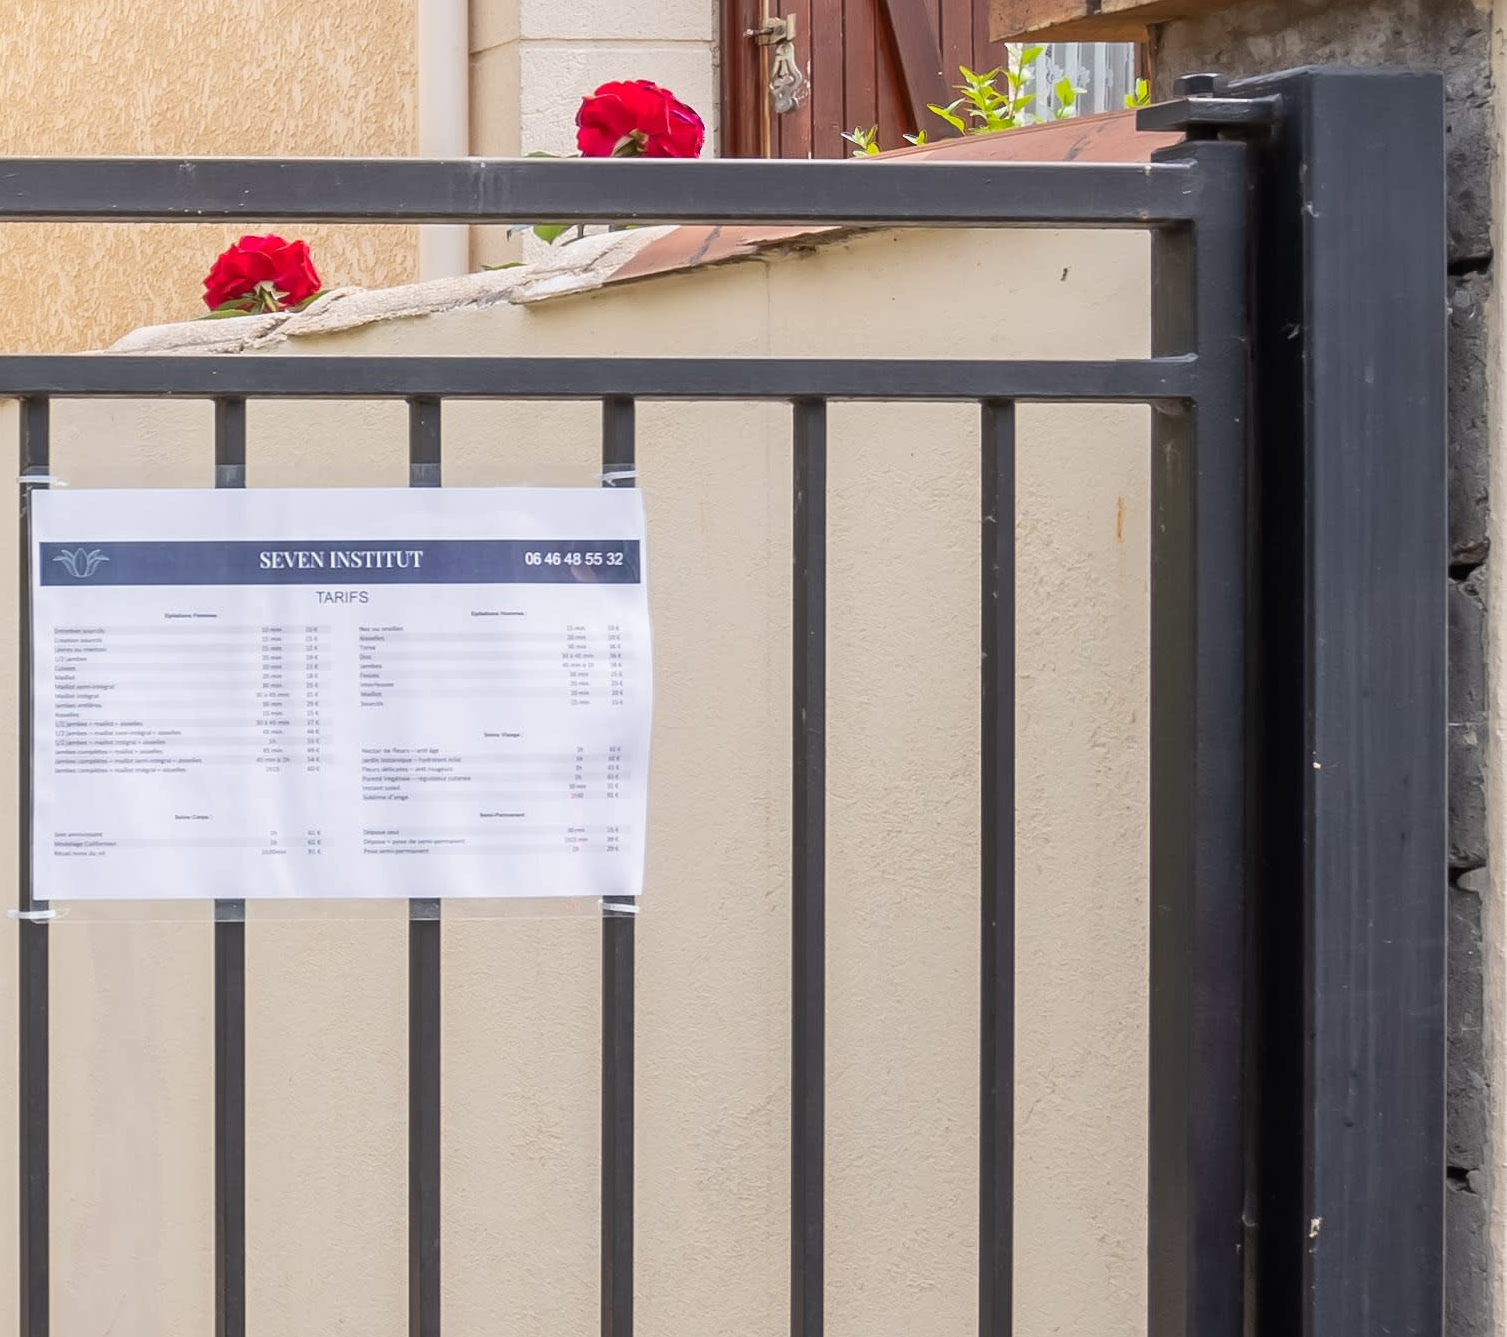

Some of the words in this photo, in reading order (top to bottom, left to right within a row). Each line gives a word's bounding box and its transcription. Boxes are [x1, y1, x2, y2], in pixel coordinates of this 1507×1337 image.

[260, 551, 324, 569] SEVEN
[330, 550, 424, 569] INSTITUT
[525, 551, 542, 566] 06
[544, 552, 561, 566] 46
[564, 552, 582, 566] 48
[585, 552, 603, 566] 55
[606, 552, 624, 566] 32
[316, 590, 369, 604] TARIFS
